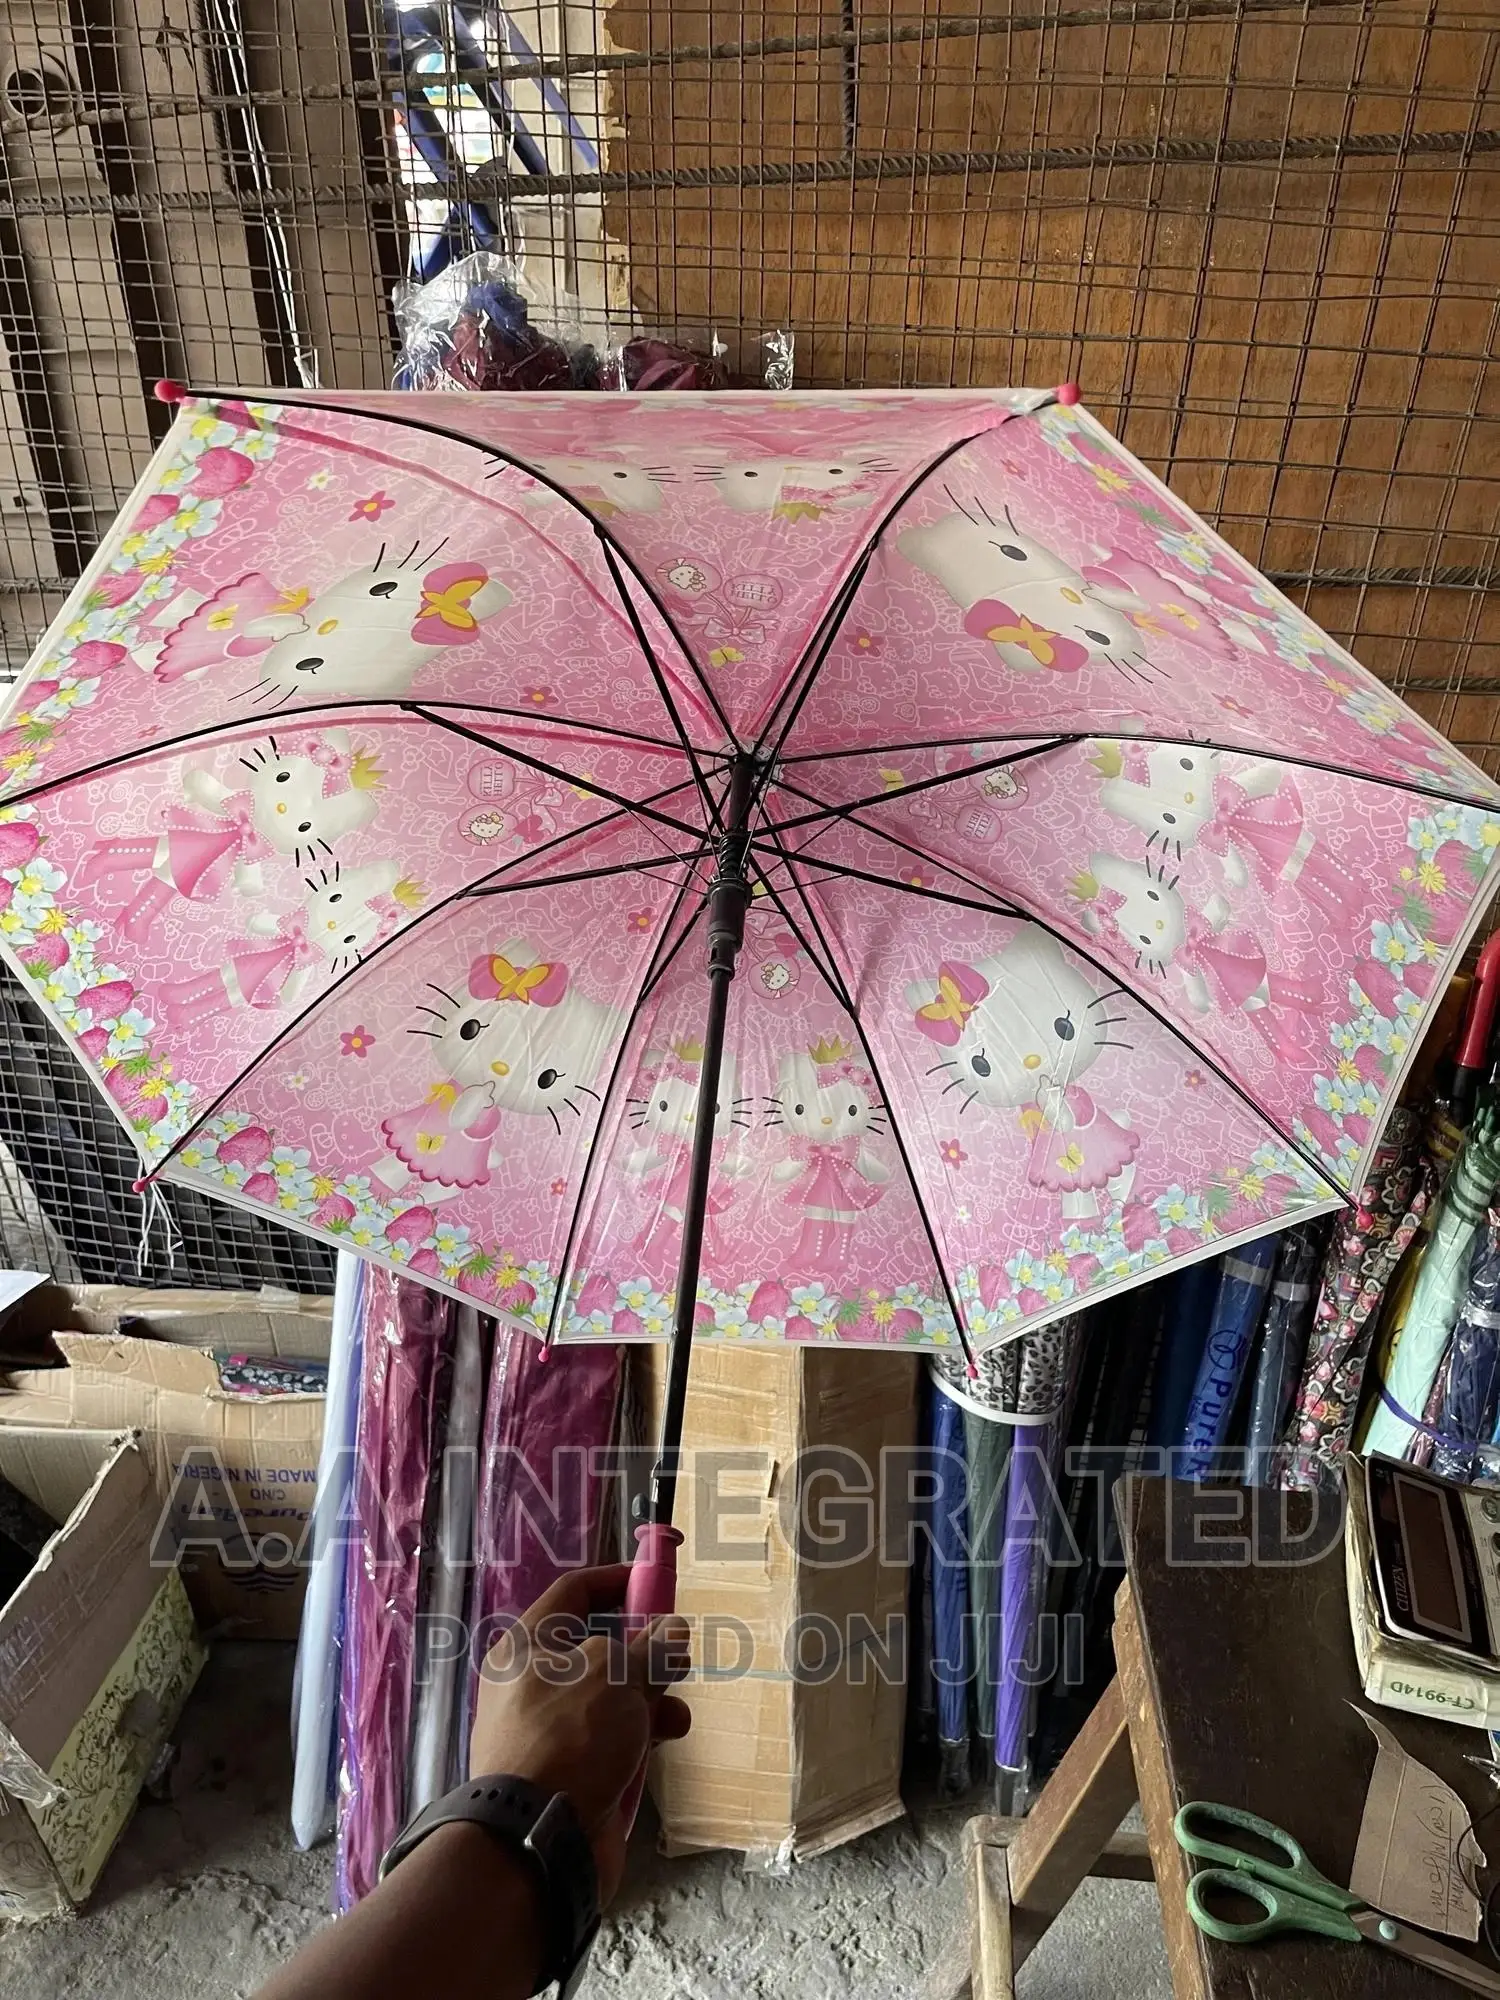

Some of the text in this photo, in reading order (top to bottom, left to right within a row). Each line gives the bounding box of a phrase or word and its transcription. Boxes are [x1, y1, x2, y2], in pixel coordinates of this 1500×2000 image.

[171, 1463, 316, 1483] MADE IN NIGERIA
[1391, 1564, 1409, 1612] CITIZEN
[1390, 1681, 1475, 1710] CT-9914D
